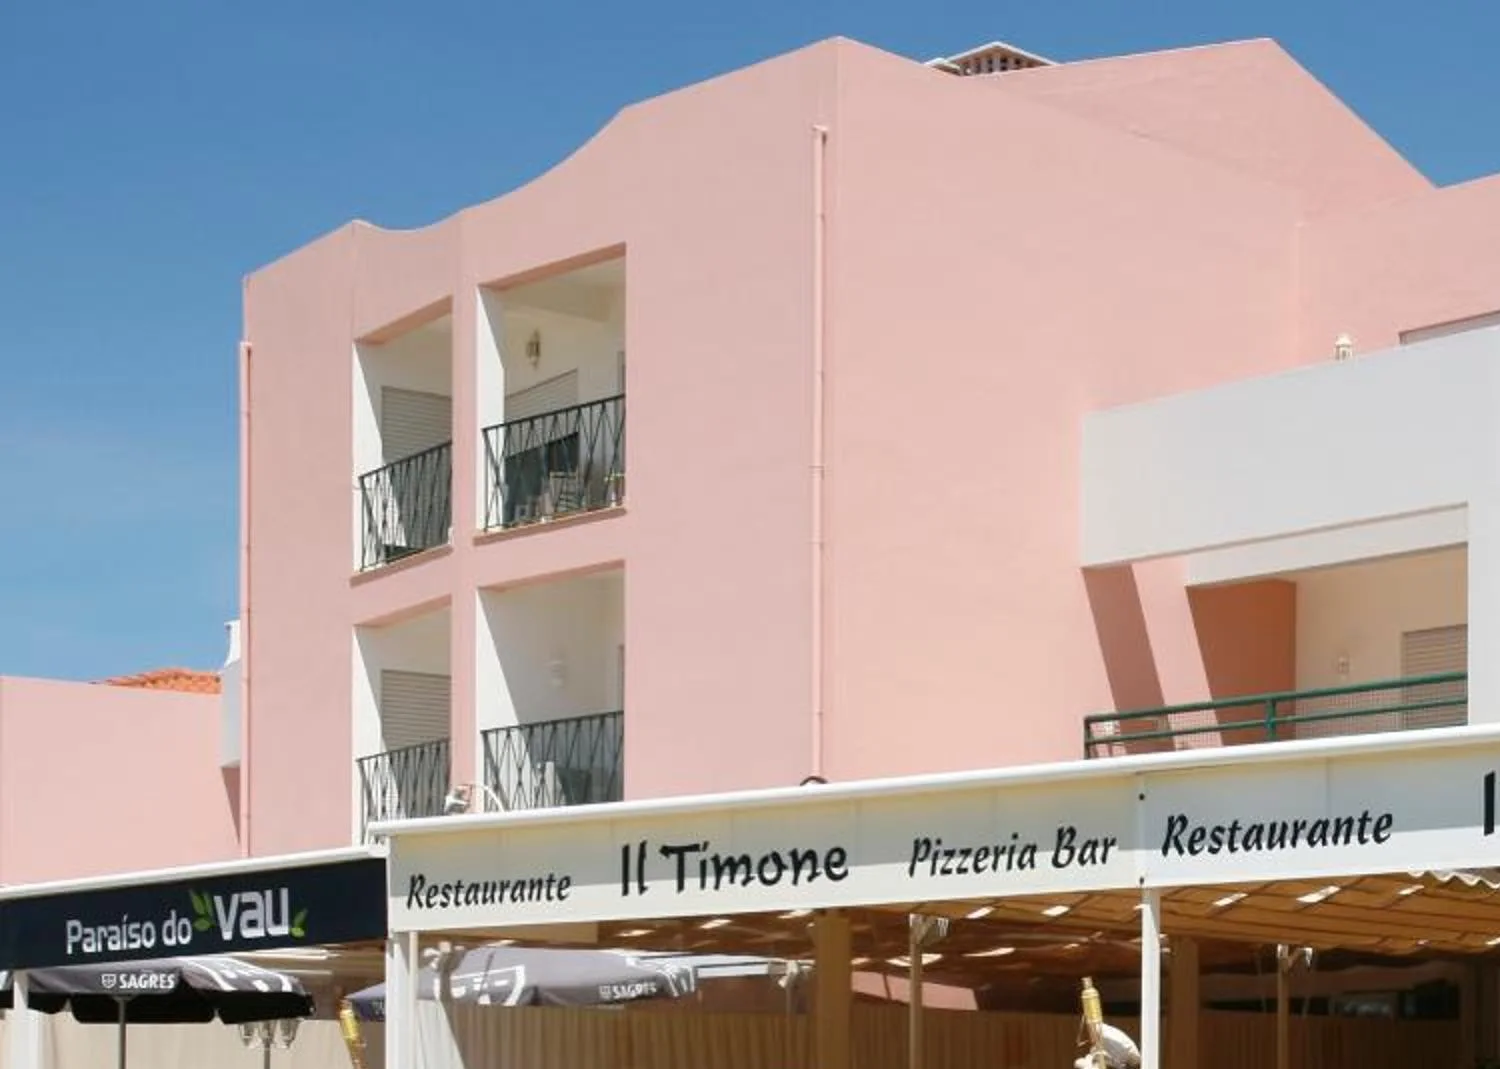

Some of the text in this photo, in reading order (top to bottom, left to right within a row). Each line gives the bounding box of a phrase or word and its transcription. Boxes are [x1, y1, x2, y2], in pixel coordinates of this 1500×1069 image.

[1162, 809, 1393, 857] Restaurante
[407, 825, 1117, 909] Restaurante Il Timone Pizzeria Bar
[65, 912, 157, 955] Paraíso
[161, 909, 193, 946] do
[118, 973, 176, 990] SAGRES
